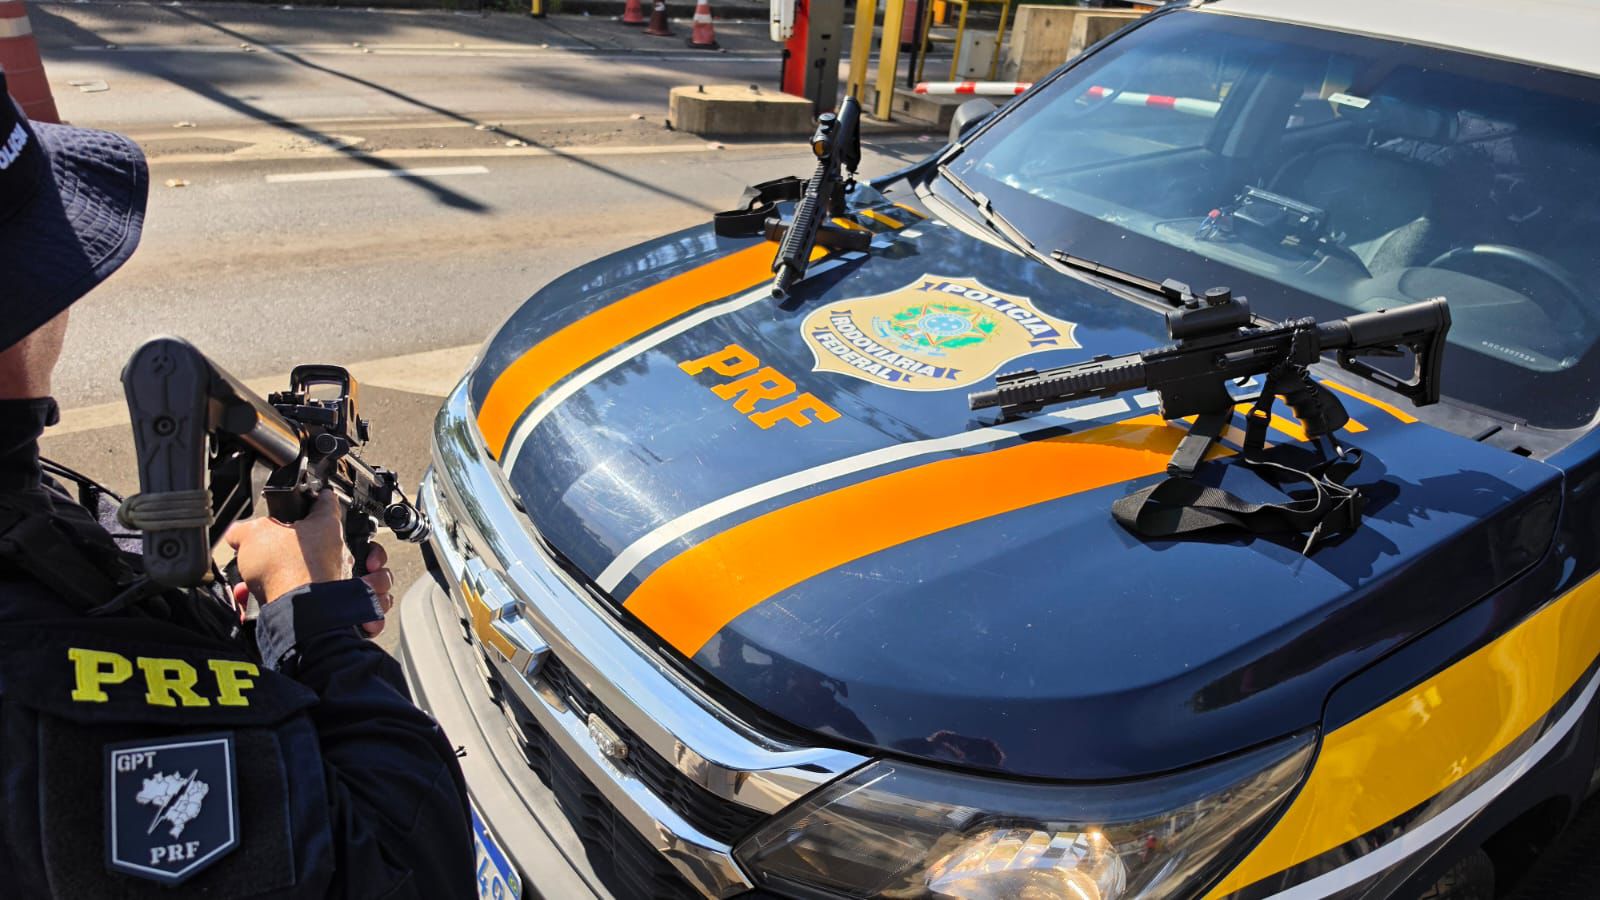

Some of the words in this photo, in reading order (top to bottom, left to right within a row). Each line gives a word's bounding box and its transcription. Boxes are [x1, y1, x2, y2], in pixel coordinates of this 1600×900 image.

[941, 283, 1053, 336] POLICIA
[816, 331, 893, 381] FEDERAL
[831, 315, 937, 377] RODOVIARIA
[678, 343, 842, 430] PRF
[68, 647, 260, 707] PRF
[117, 751, 157, 772] GPT
[149, 841, 200, 865] PRF
